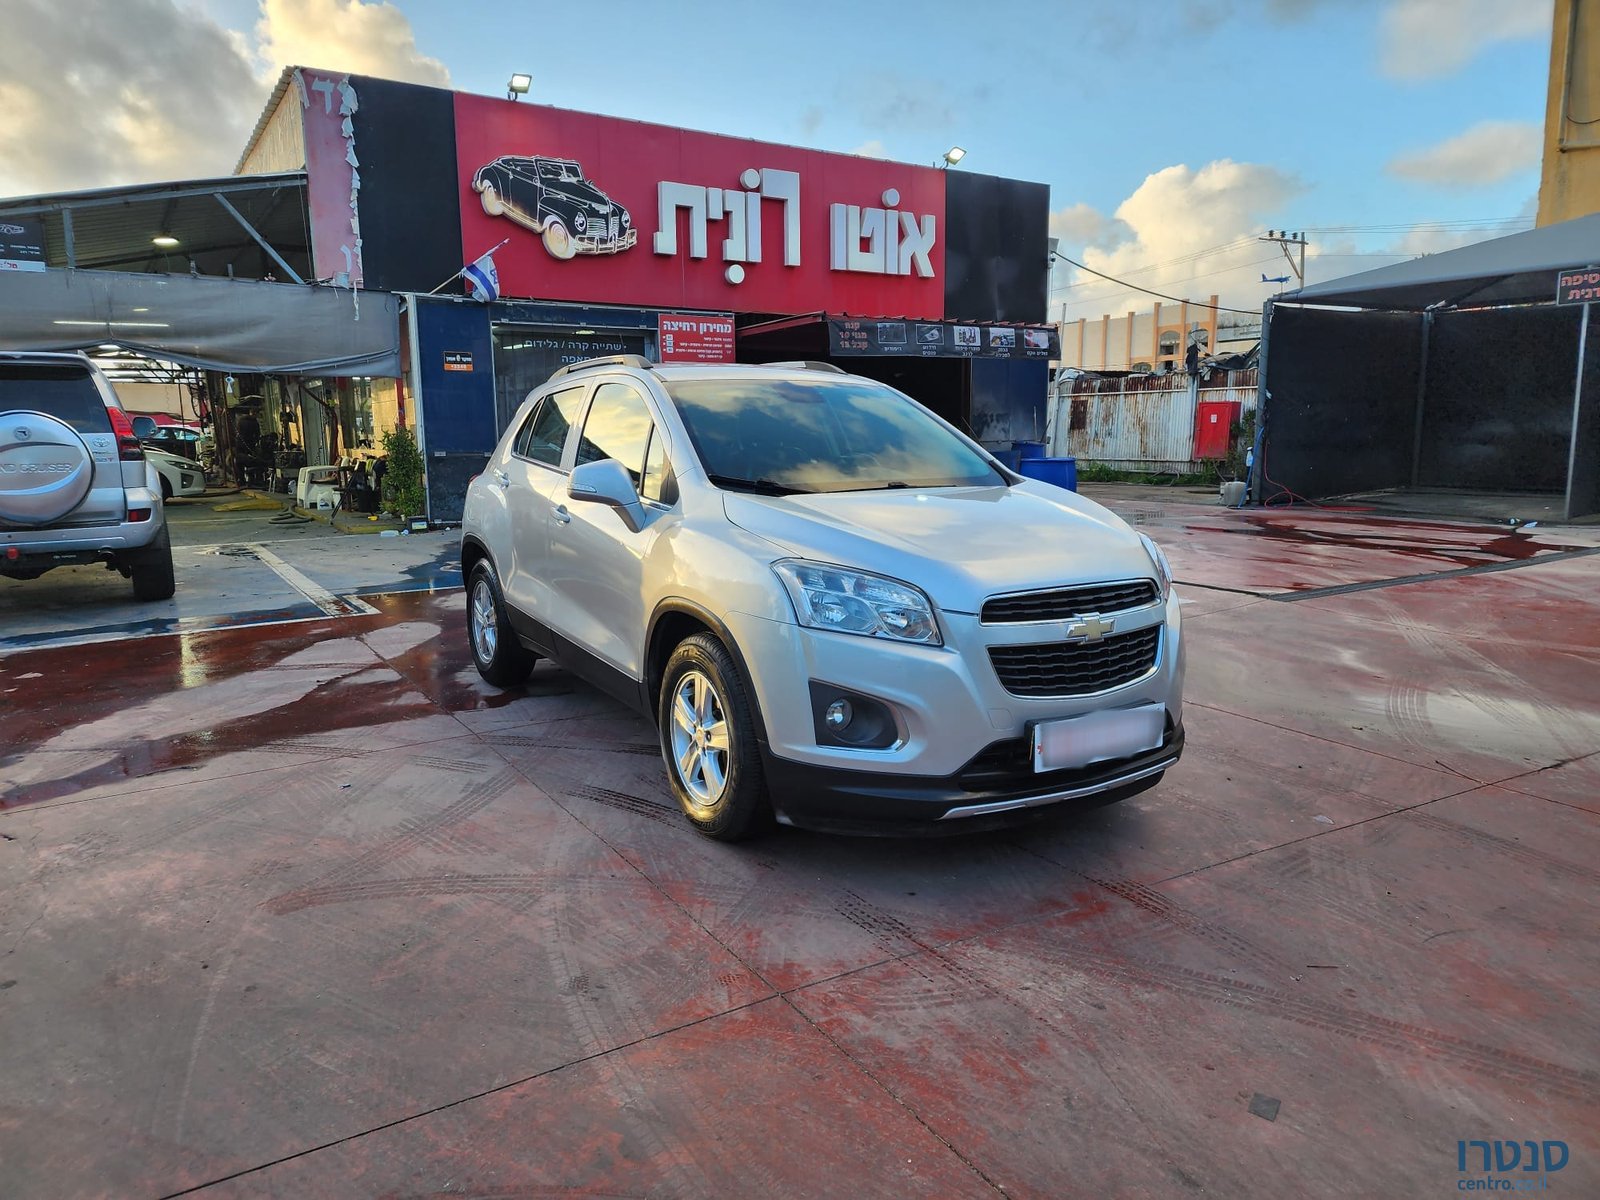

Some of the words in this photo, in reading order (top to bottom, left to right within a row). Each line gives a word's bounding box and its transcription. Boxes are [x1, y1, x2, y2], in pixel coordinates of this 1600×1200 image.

[663, 319, 697, 332] רחיצה
[699, 321, 732, 335] מחירון
[568, 341, 589, 351] קרה
[592, 342, 622, 351] שתייה
[19, 463, 73, 473] CRUISER
